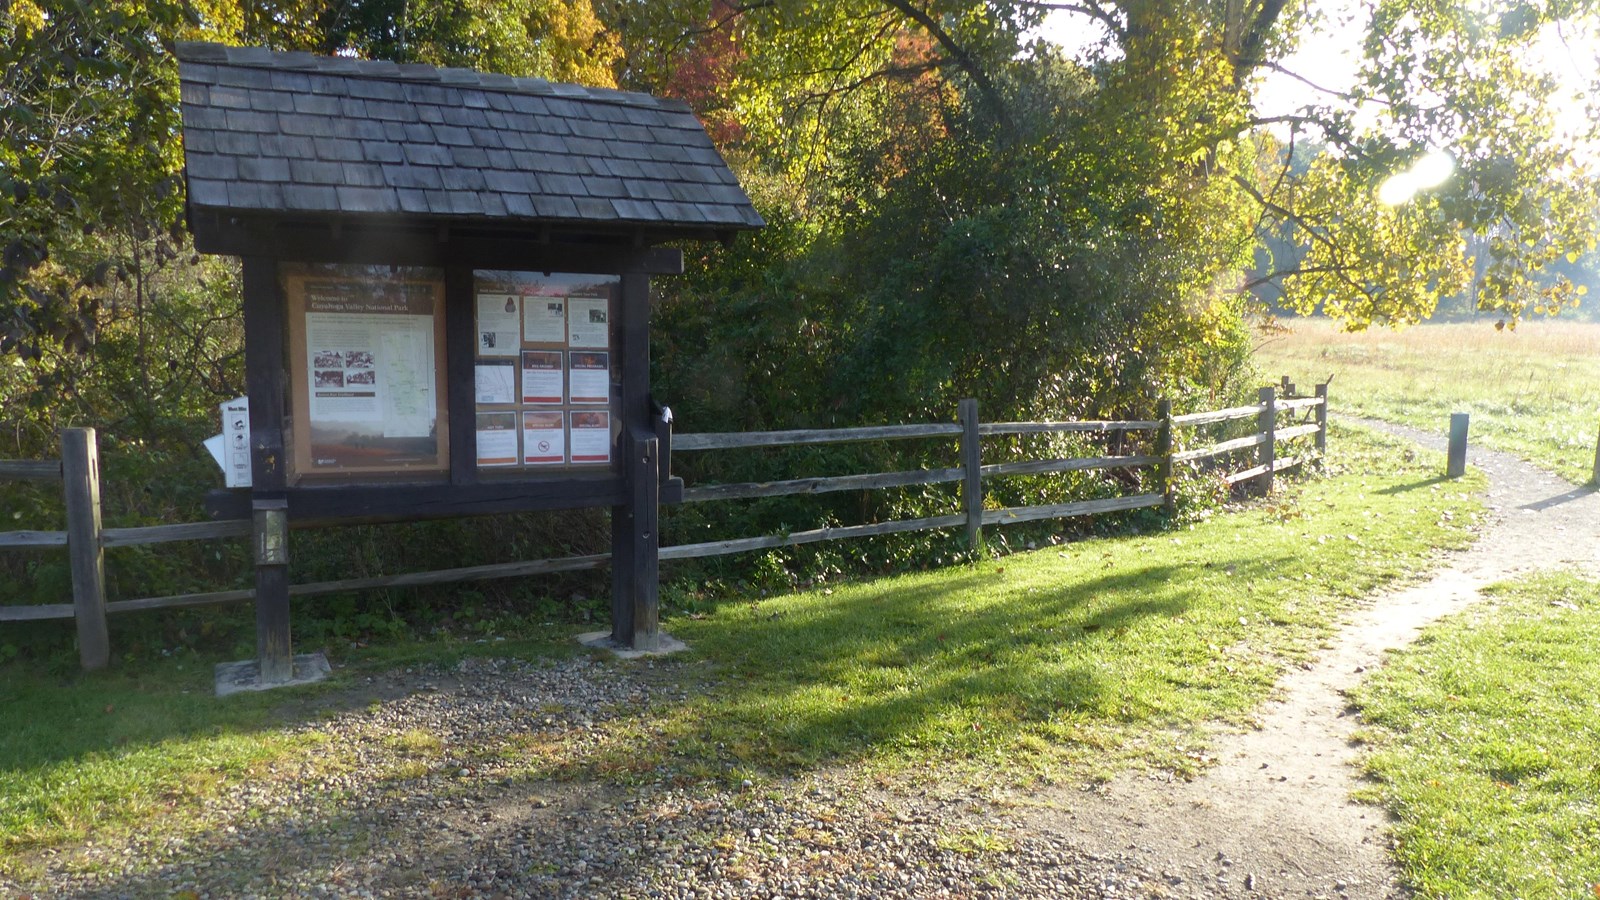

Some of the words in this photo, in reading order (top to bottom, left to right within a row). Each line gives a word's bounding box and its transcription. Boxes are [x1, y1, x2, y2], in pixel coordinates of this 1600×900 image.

[311, 294, 340, 302] Welcome
[311, 303, 344, 311] Cuyahoga
[345, 303, 364, 311] Valley
